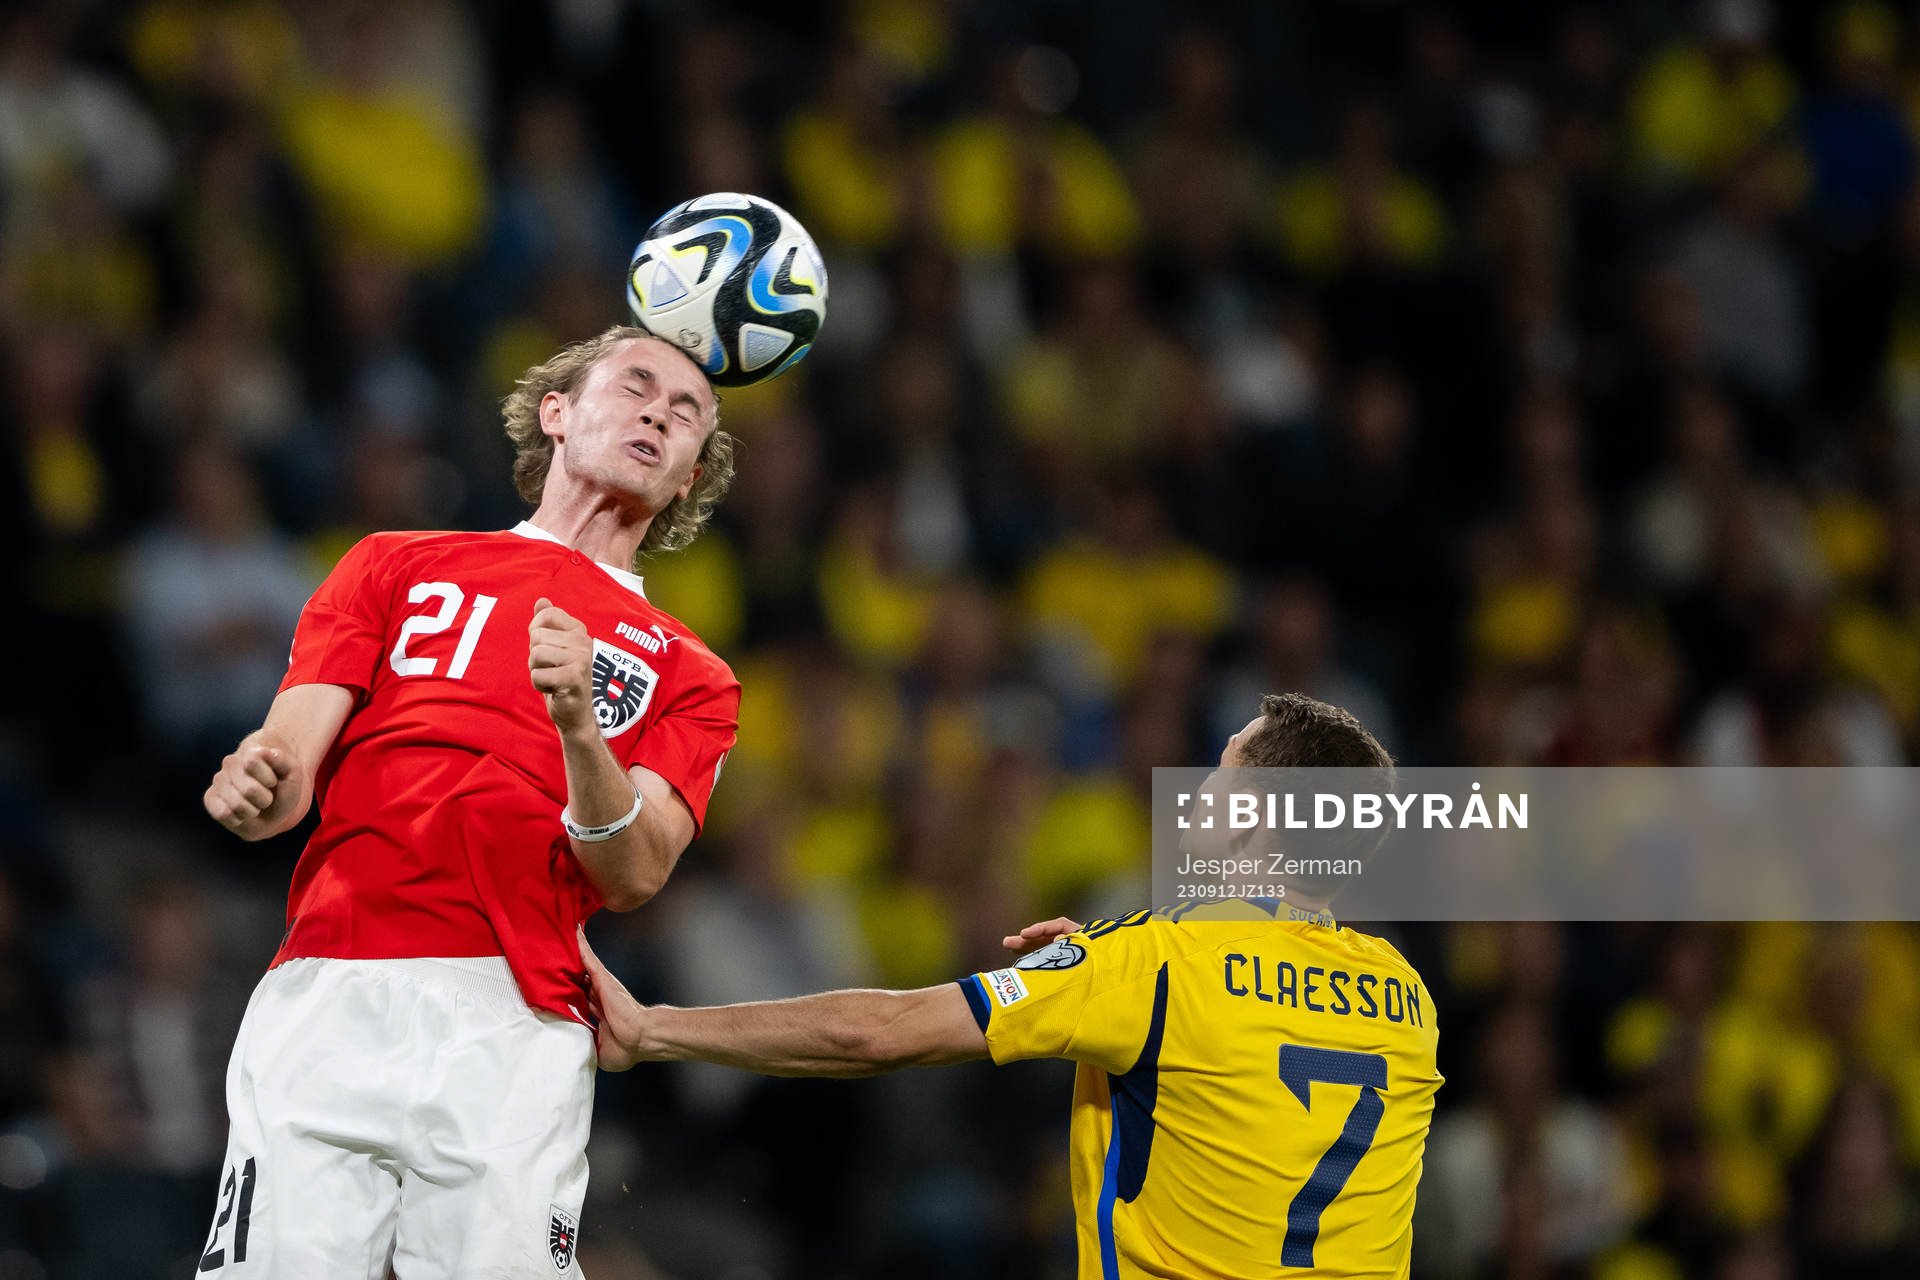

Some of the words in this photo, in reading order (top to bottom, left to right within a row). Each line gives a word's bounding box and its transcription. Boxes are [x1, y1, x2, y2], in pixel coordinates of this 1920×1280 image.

[389, 581, 498, 680] 21
[612, 652, 642, 672] ÖFB
[614, 621, 661, 654] PUMA
[1224, 953, 1424, 1028] CLAESSON
[1278, 1043, 1388, 1268] 7
[199, 1156, 257, 1272] 21
